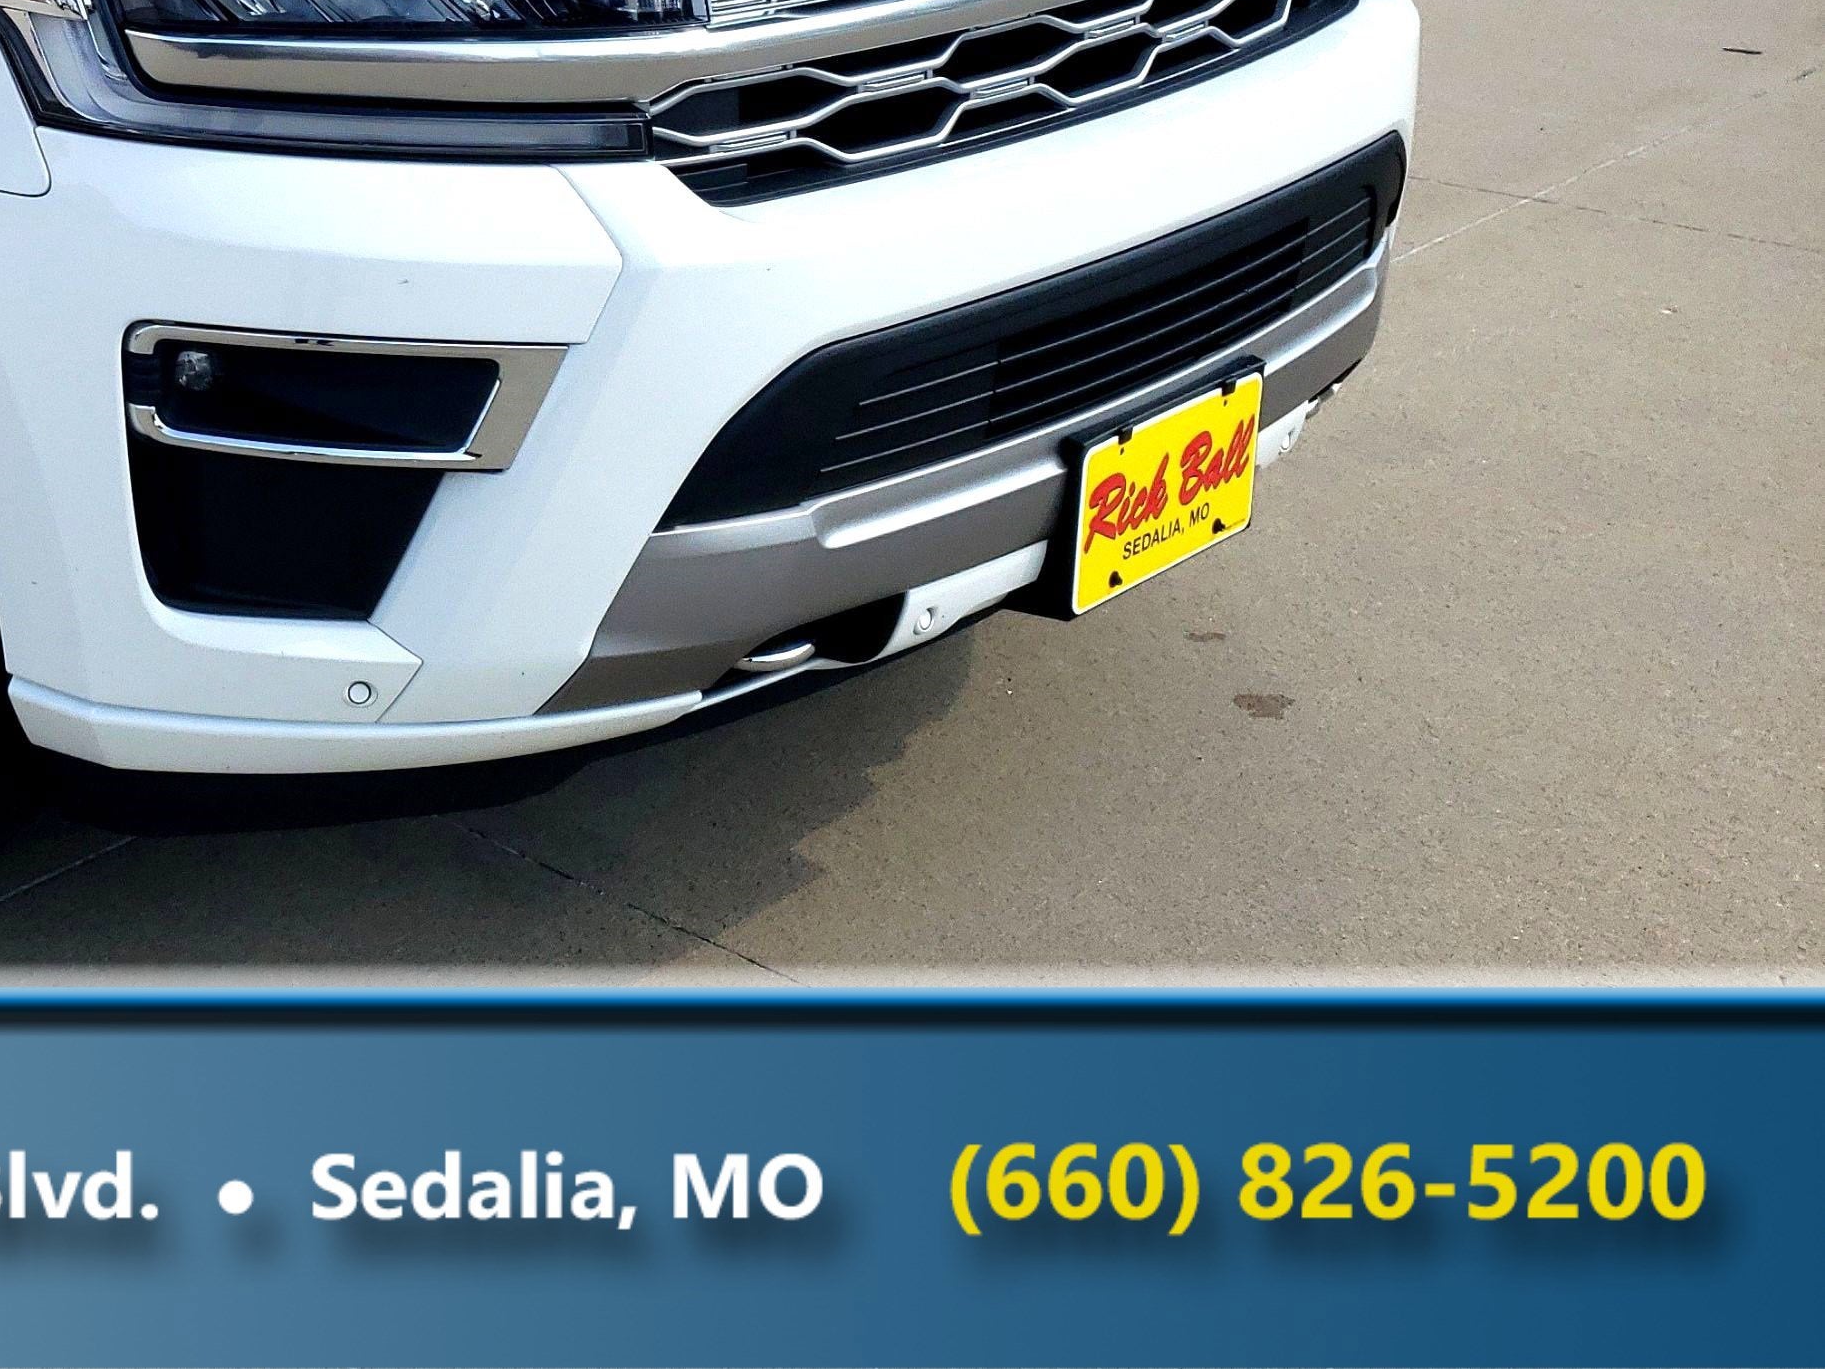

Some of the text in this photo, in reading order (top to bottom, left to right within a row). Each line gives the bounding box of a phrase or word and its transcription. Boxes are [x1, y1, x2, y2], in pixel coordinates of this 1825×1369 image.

[1083, 414, 1256, 555] Rick Ball
[1122, 501, 1211, 561] SEDALIA, MO
